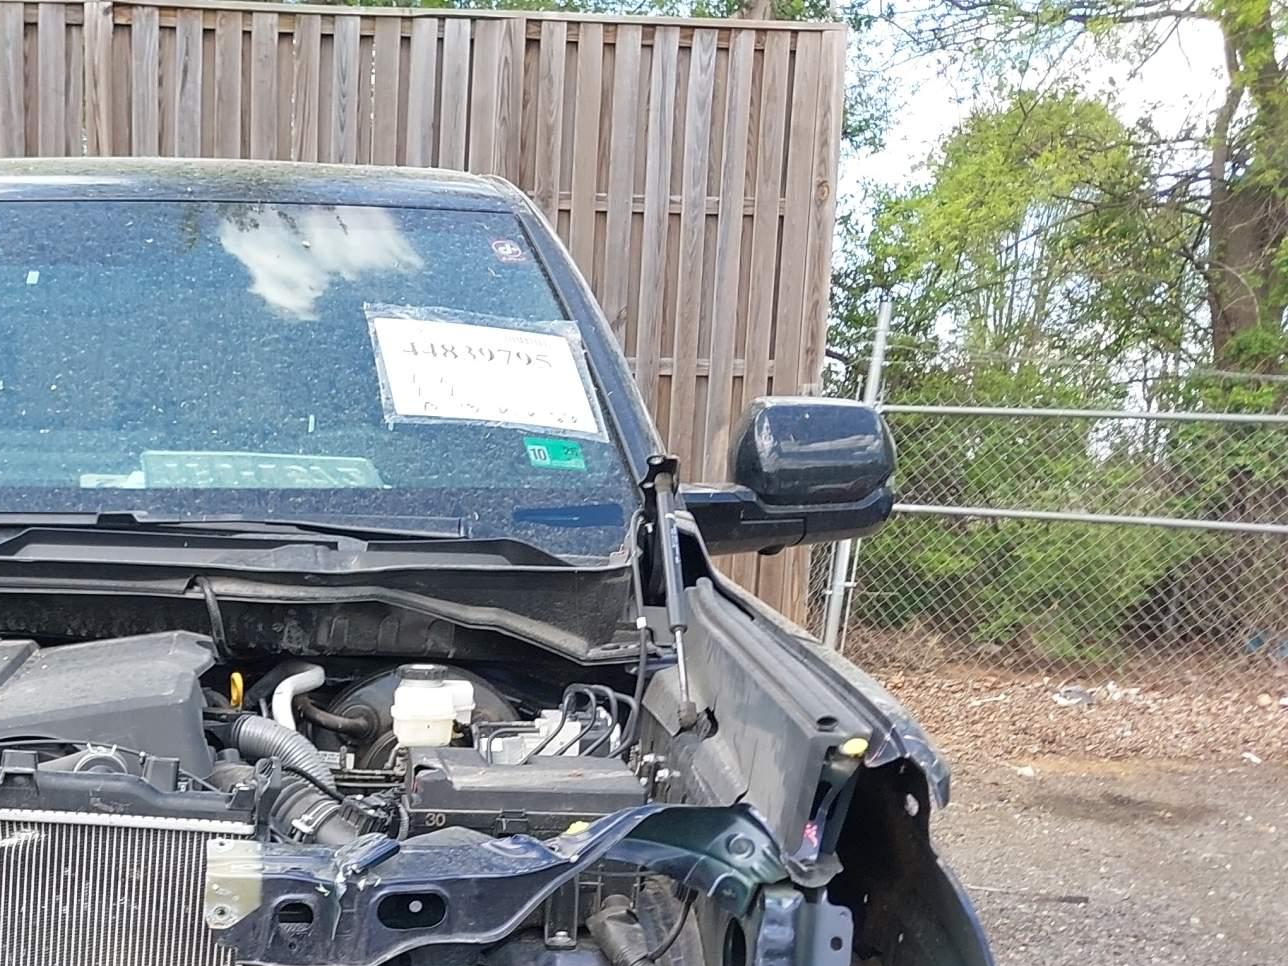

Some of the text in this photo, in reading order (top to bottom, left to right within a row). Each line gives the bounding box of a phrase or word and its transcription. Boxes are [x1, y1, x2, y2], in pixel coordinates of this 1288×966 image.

[402, 342, 553, 369] 44839795
[529, 447, 547, 461] 10
[425, 812, 447, 827] 30
